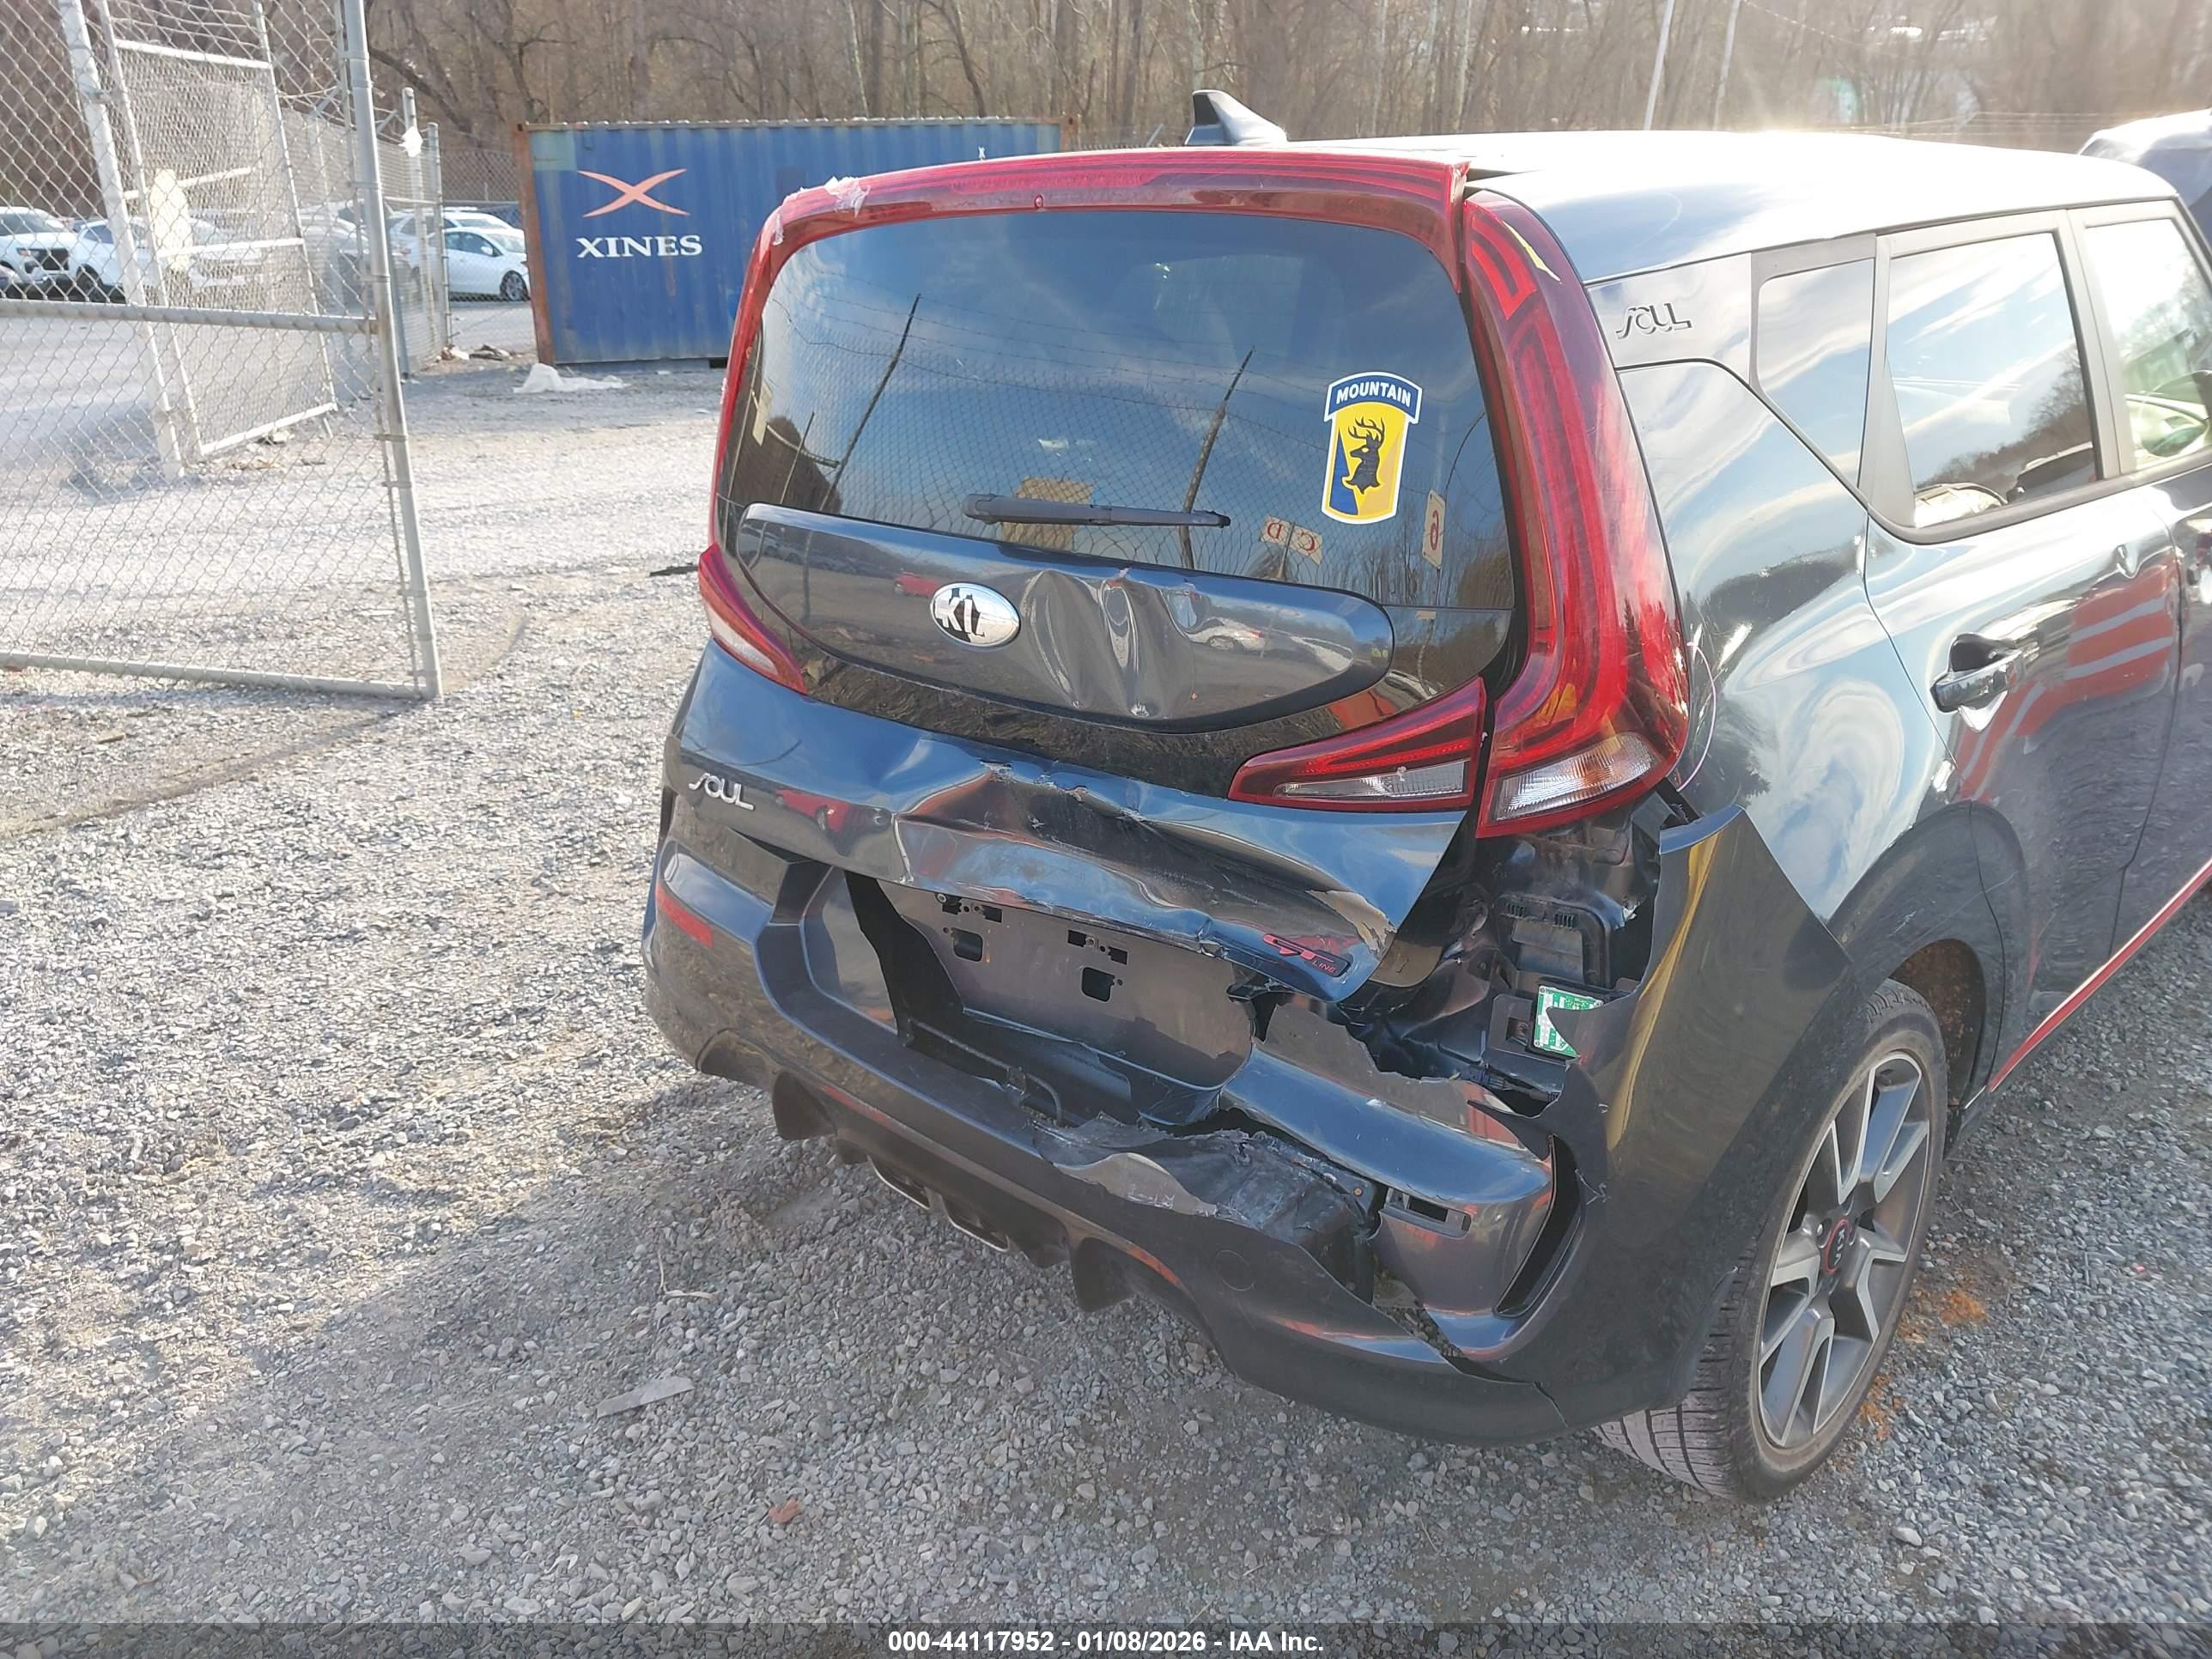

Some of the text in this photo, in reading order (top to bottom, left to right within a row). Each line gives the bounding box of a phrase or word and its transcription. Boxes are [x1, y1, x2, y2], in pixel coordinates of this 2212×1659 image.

[576, 234, 702, 258] XINES
[1335, 381, 1412, 408] MOUNTAIN
[688, 772, 755, 811] SOUL
[1311, 959, 1337, 973] LINE
